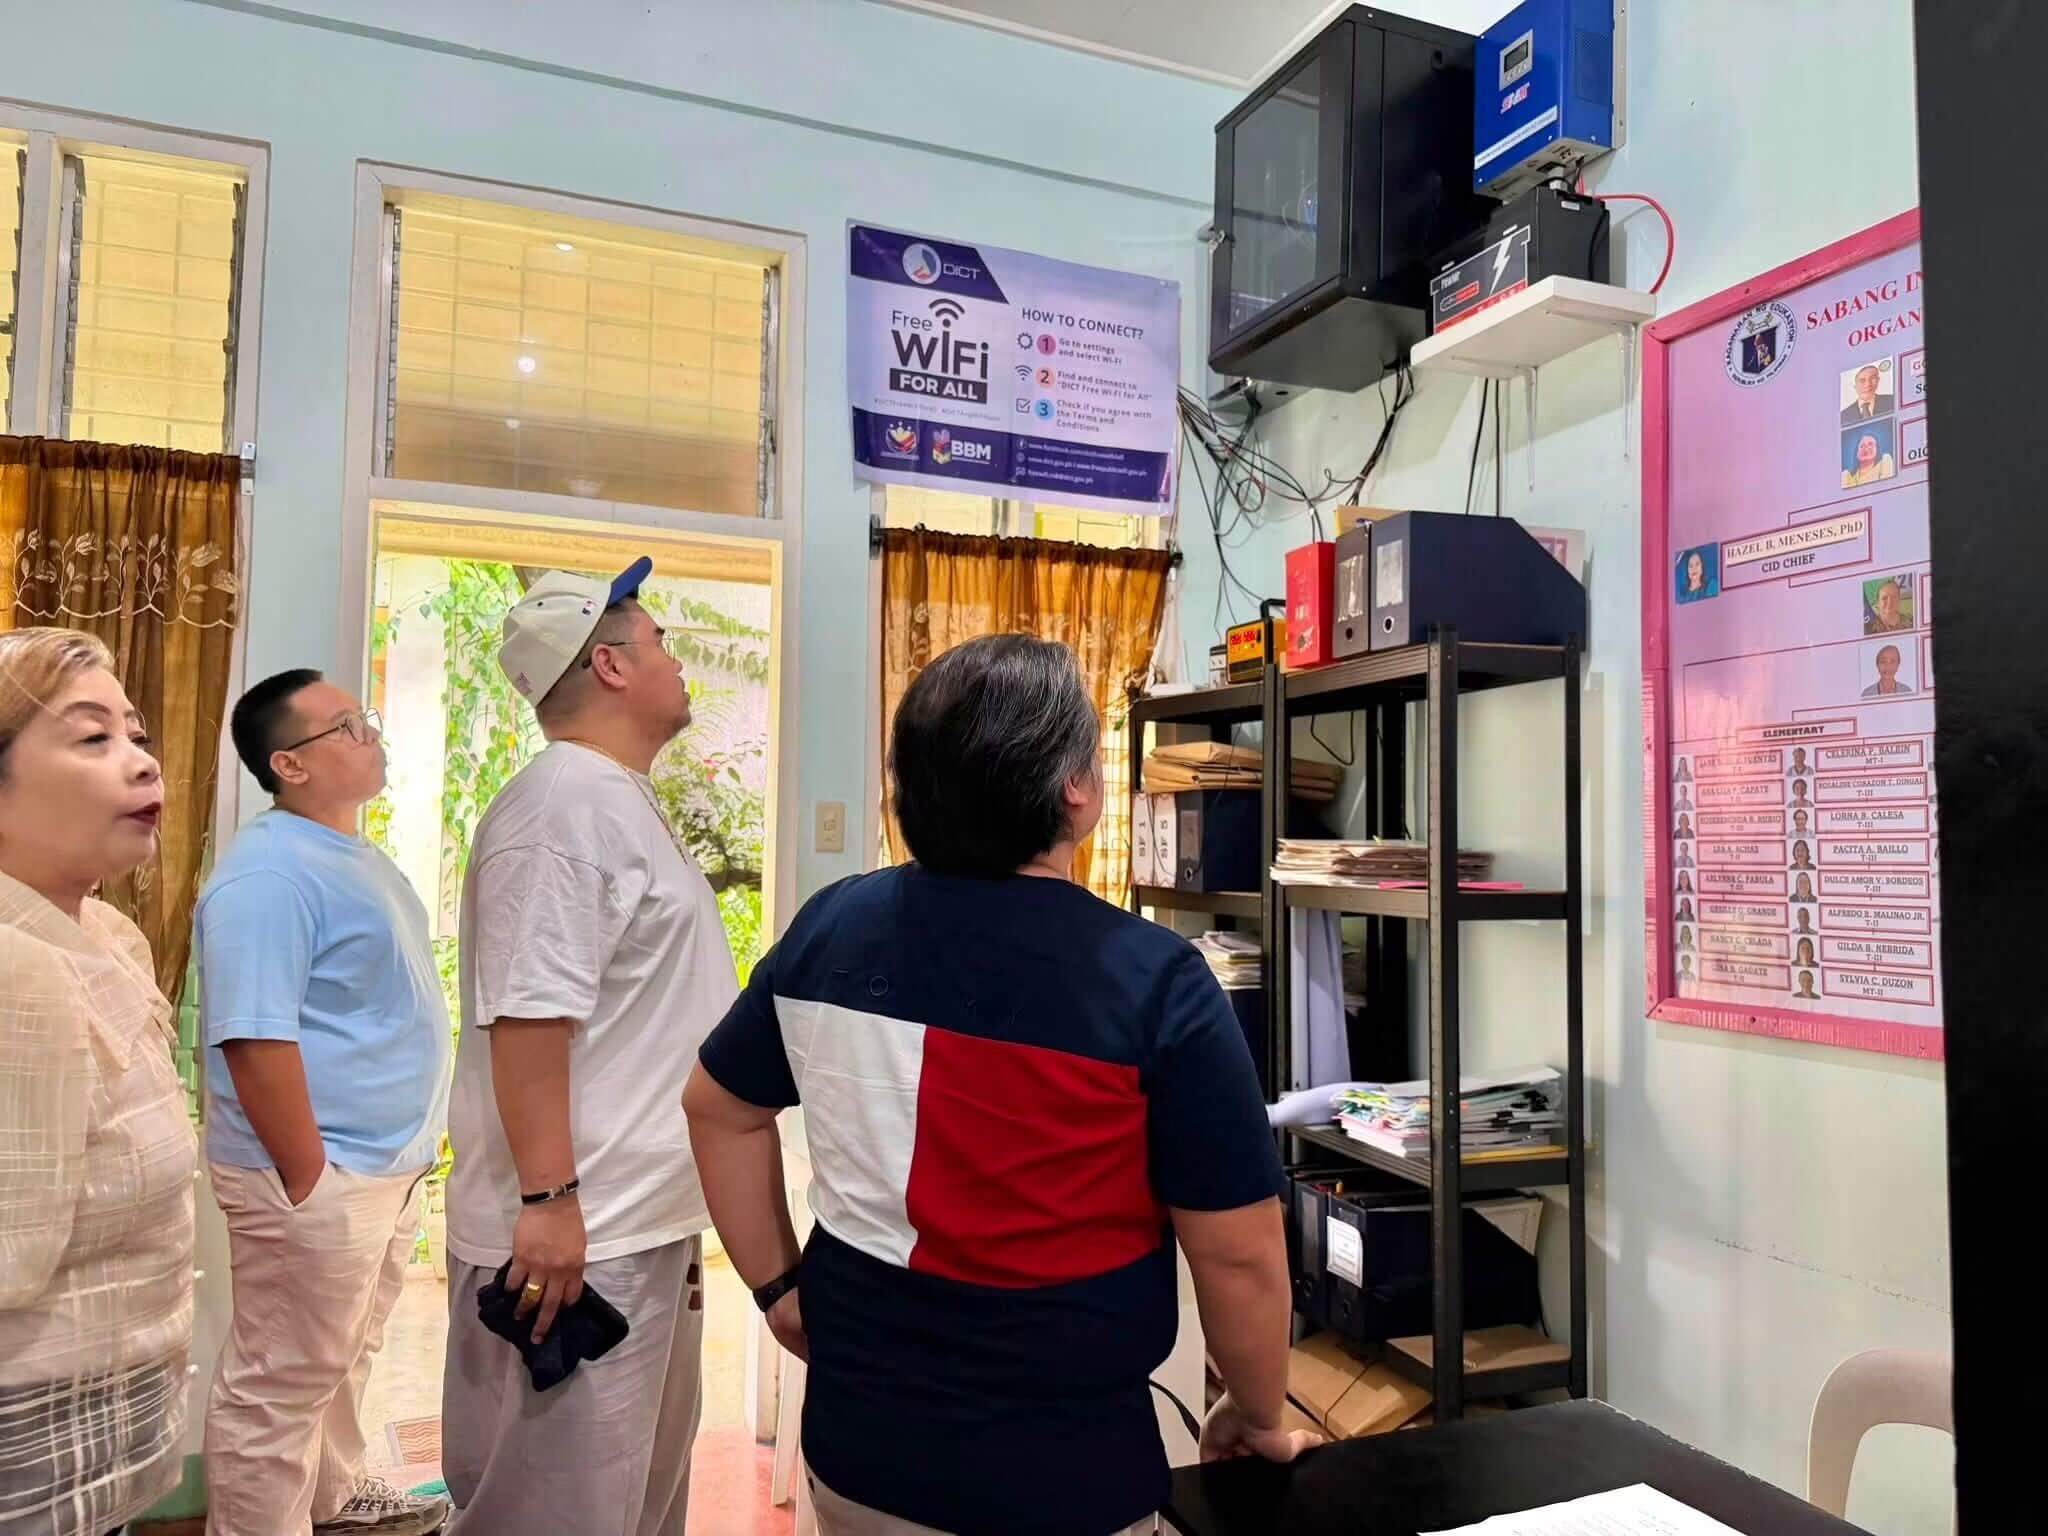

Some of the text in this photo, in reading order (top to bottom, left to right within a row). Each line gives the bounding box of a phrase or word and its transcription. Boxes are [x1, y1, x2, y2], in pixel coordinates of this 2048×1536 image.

[943, 263, 981, 280] DICT
[1806, 280, 1898, 330] SABANG
[891, 309, 933, 331] Free
[1021, 307, 1144, 340] HOW TO CONNECT?
[1042, 337, 1049, 352] 1
[1083, 340, 1115, 355] settings
[1059, 348, 1074, 357] and
[1076, 350, 1100, 361] select
[1040, 369, 1050, 384] 2
[1058, 370, 1076, 381] Find
[1078, 373, 1093, 383] and
[1095, 377, 1127, 389] connect
[899, 373, 978, 400] FOR ALL
[1081, 385, 1100, 395] Free
[1039, 401, 1049, 417] 3
[1057, 399, 1081, 410] Check
[1091, 404, 1106, 415] you
[1108, 407, 1131, 418] agree
[1133, 411, 1151, 419] with
[1057, 410, 1114, 425] the Terms and
[1057, 419, 1100, 432] Conditions
[951, 440, 991, 460] BBM
[1727, 543, 1762, 559] HAZEL
[1777, 525, 1837, 547] MENESES,
[1840, 520, 1863, 535] PhD
[1761, 553, 1816, 573] CID CHIEF
[1762, 725, 1824, 737] ELEMENTARY
[1825, 747, 1866, 759] CELERINA
[1830, 812, 1859, 820] LORNA
[1871, 810, 1904, 820] CALESA
[1824, 875, 1849, 884] DULCE
[1851, 876, 1874, 885] AMOR
[1828, 909, 1862, 918] ALFREDO
[1873, 911, 1911, 920] MALINAO
[1912, 912, 1925, 921] JR.
[1837, 942, 1863, 952] GILDA
[1839, 974, 1870, 985] SYLVIA
[1882, 977, 1913, 989] DUZON
